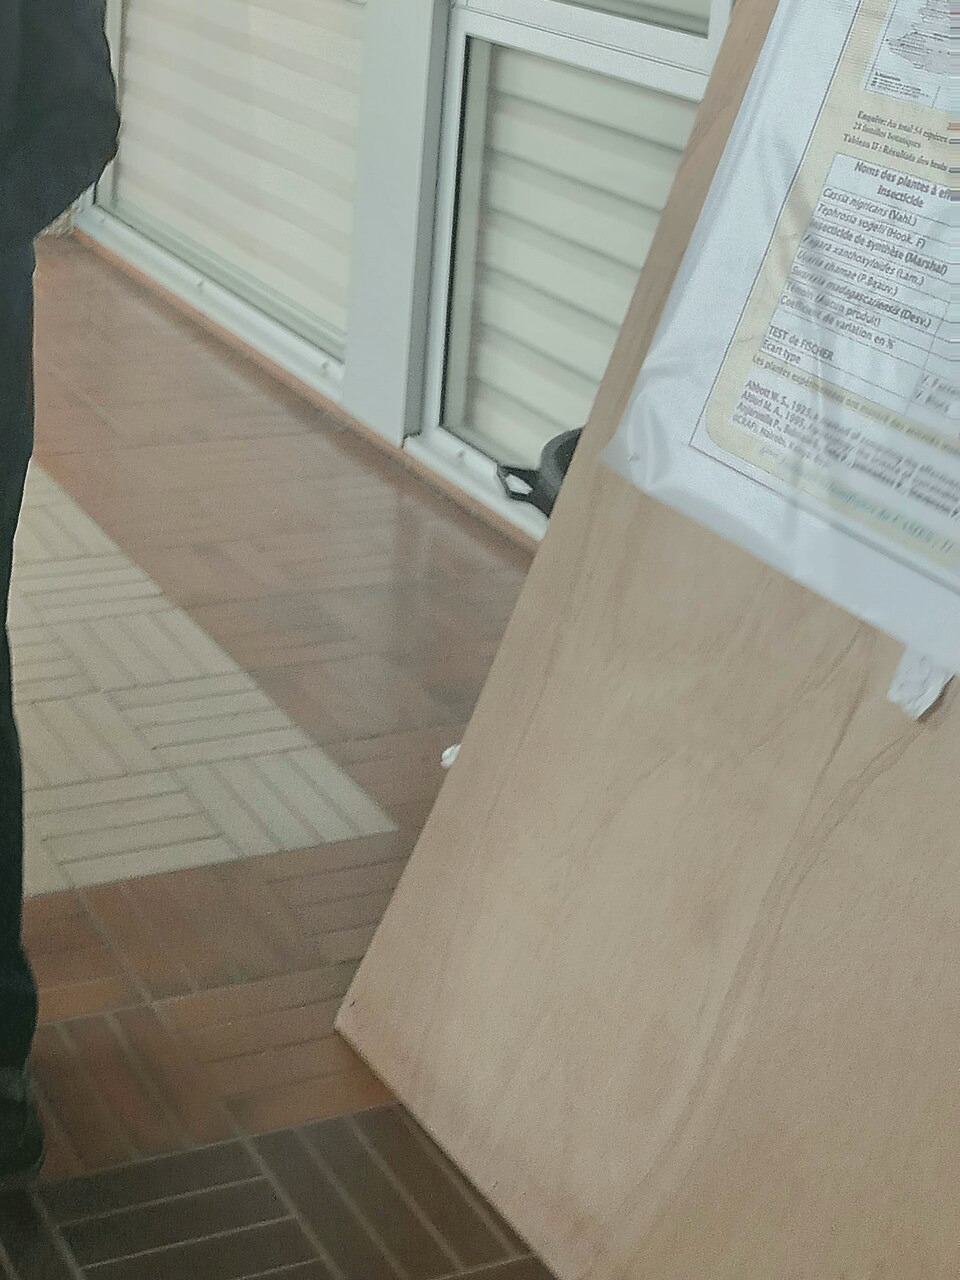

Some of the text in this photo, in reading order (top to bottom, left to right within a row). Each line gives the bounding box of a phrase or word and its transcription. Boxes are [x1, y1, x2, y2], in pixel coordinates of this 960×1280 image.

[854, 161, 879, 178] Noms
[880, 170, 896, 182] des
[896, 176, 930, 194] plantes
[930, 184, 938, 196] à
[818, 203, 858, 225] Tephrosia
[823, 188, 848, 204] Cassia
[848, 198, 889, 218] nigricans
[854, 234, 866, 246] de
[866, 240, 905, 260] synthèse
[824, 260, 857, 280] chamae
[826, 279, 900, 316] madagascariensis
[900, 308, 932, 328] (Desv.)
[845, 306, 881, 327] produit)
[768, 325, 834, 362] TEST de FISCHER
[823, 312, 834, 325] de
[836, 320, 872, 340] variation
[874, 335, 885, 345] en
[886, 338, 896, 350] %
[752, 354, 764, 366] Les
[764, 361, 790, 379] plantes
[783, 347, 801, 365] type
